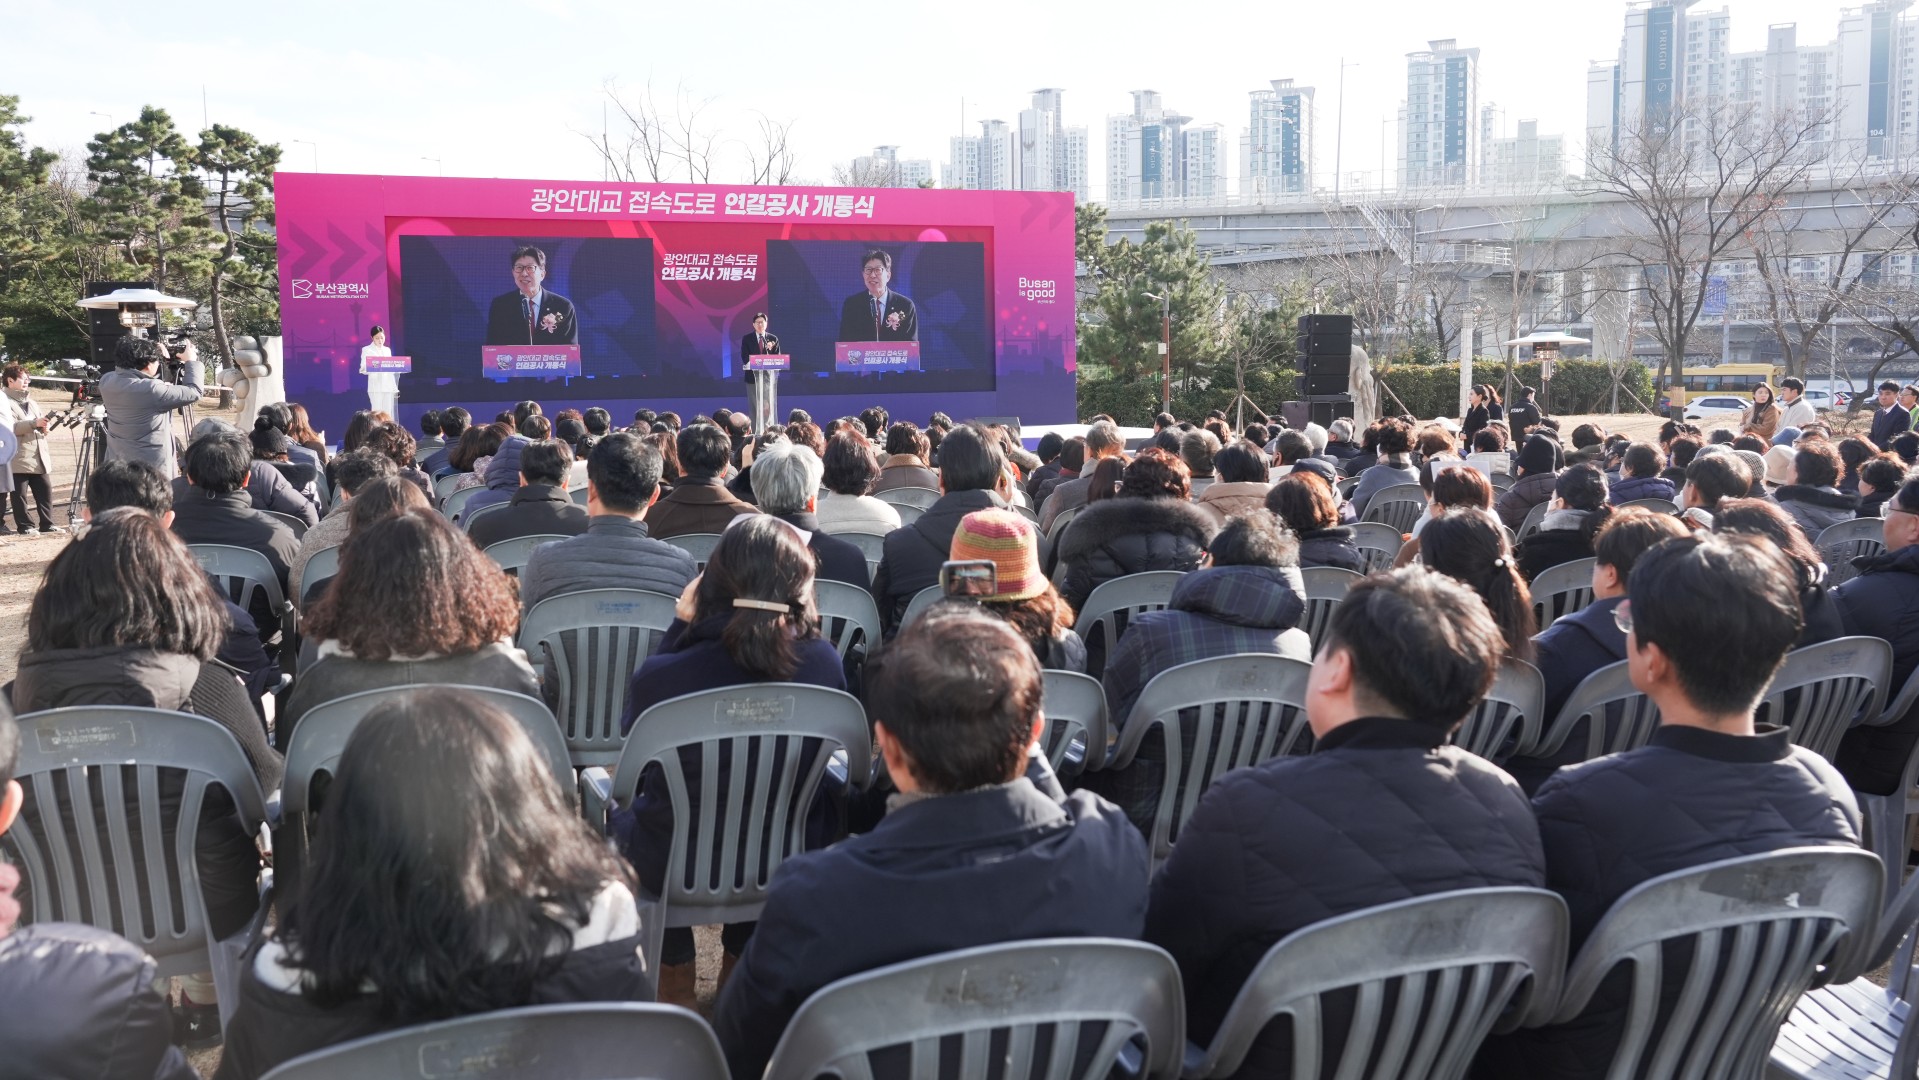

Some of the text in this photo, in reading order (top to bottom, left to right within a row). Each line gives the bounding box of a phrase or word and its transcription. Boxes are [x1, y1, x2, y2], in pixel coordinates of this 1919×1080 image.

[1659, 29, 1668, 70] PRUGIO
[530, 188, 875, 218] 광안대교 접속도로 연결공사 개통식
[663, 253, 758, 266] 광안대교 접속도로
[661, 267, 757, 281] 연결공사 개통식
[315, 283, 369, 295] 부산광역시
[1019, 277, 1056, 288] Busan
[1019, 287, 1056, 301] is good
[515, 361, 566, 370] 연결공사 개통식
